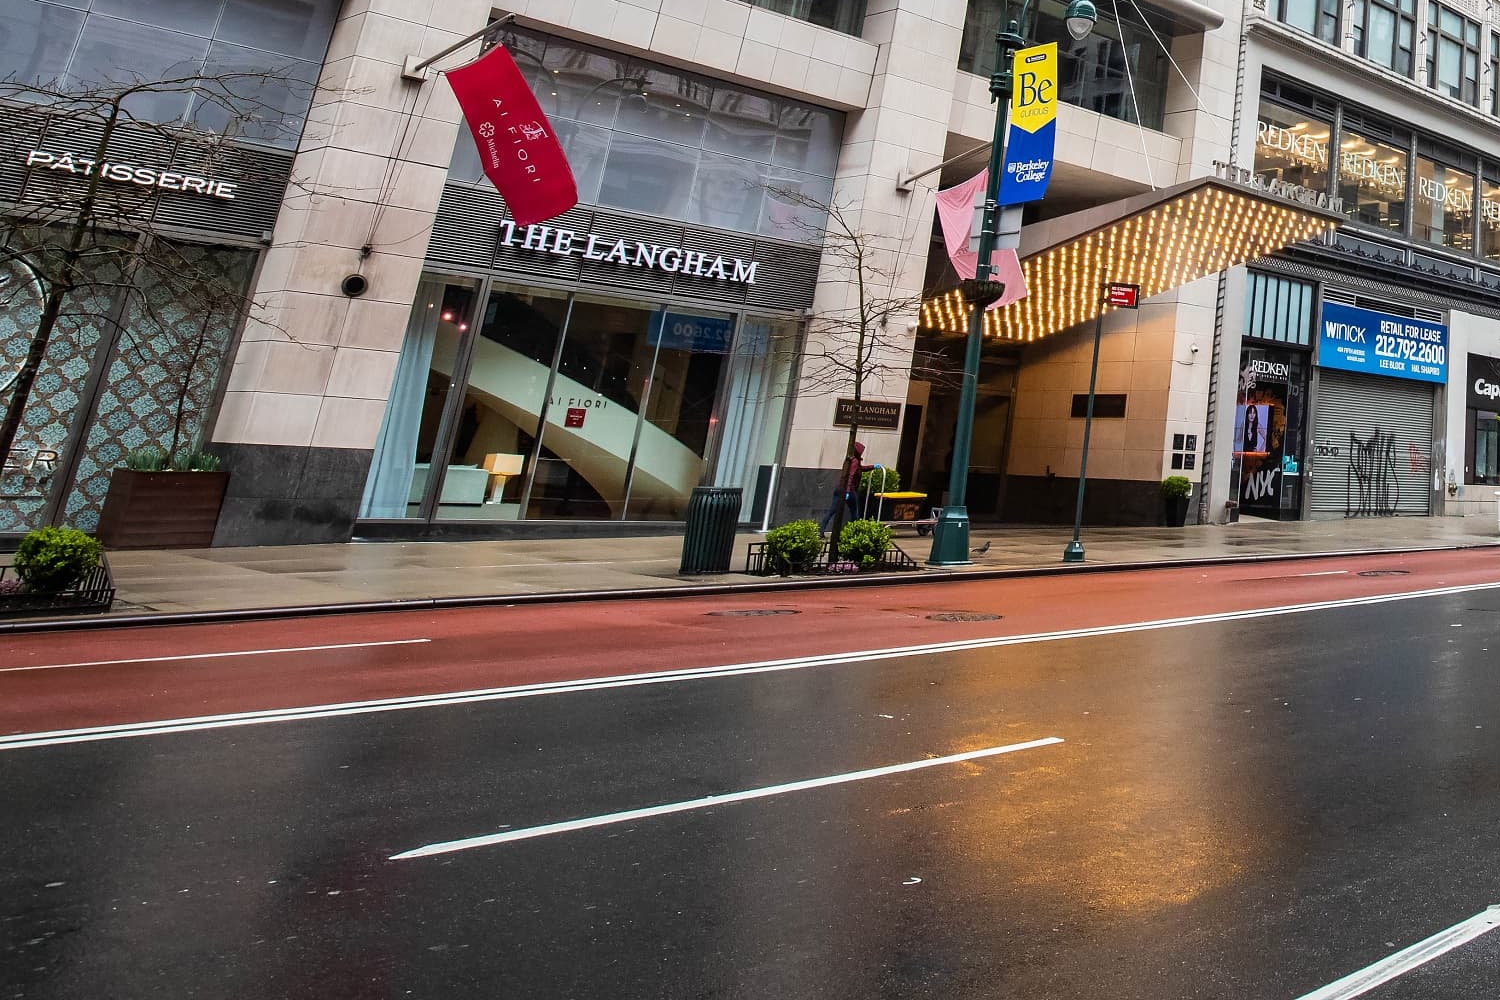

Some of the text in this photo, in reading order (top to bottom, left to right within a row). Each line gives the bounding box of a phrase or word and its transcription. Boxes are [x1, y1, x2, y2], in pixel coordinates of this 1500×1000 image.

[1018, 71, 1053, 108] Be
[486, 137, 500, 169] Michelin
[507, 126, 541, 182] FIORI
[1256, 120, 1327, 163] REDKEN
[26, 149, 238, 200] PÂTISSERIE
[1015, 170, 1046, 183] College
[1016, 159, 1049, 173] Berkeley
[1343, 150, 1404, 188] REDKEN
[1418, 176, 1472, 211] REDKEN
[500, 219, 759, 285] THE LANGHAM
[1380, 320, 1441, 343] RETAIL FOR LEASE
[1374, 334, 1445, 365] 212.792.2600
[1379, 359, 1389, 369] LEE
[1389, 361, 1405, 371] BLOCK
[1411, 363, 1420, 372] HAL
[1252, 360, 1288, 377] REDKEN
[568, 398, 608, 409] FIORI
[859, 405, 897, 415] LANGHAM
[1245, 467, 1280, 500] NYC
